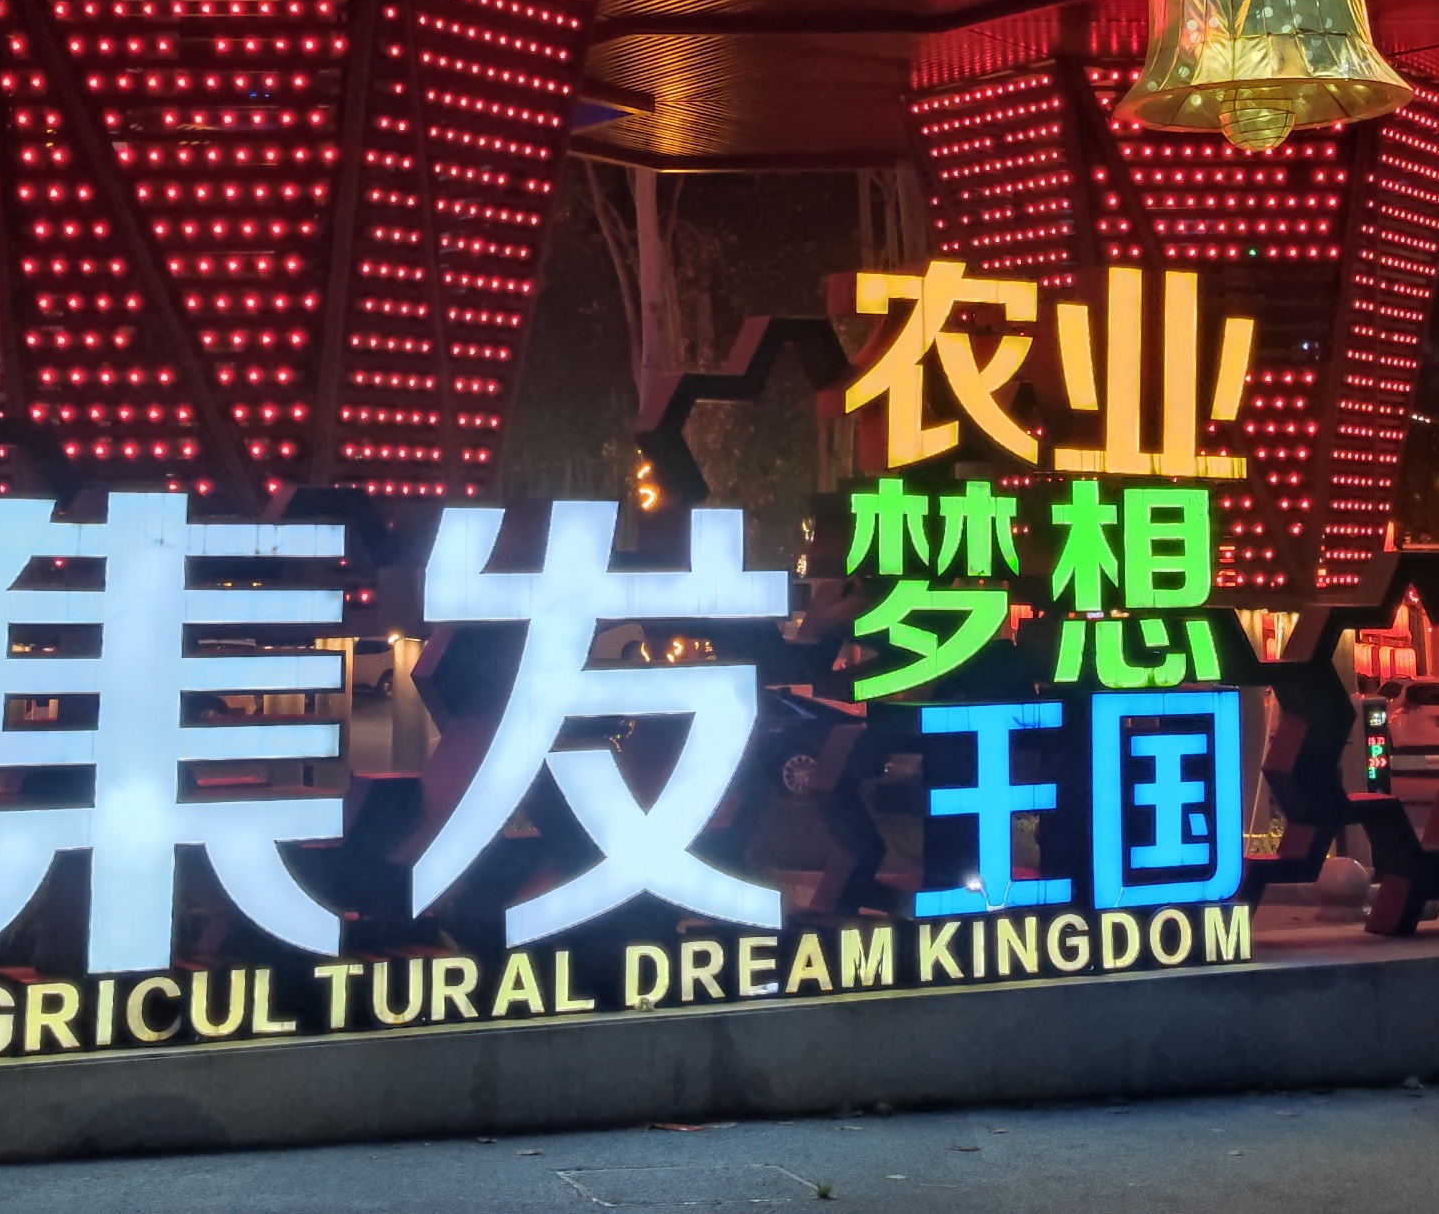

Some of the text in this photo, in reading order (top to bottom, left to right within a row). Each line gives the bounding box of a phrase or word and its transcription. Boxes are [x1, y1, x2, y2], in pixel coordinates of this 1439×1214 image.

[845, 261, 1254, 478] 农业
[846, 478, 1221, 701] 梦想
[915, 691, 1243, 917] 王国
[625, 926, 894, 1011] DREAM
[919, 904, 1251, 983] KINGDOM
